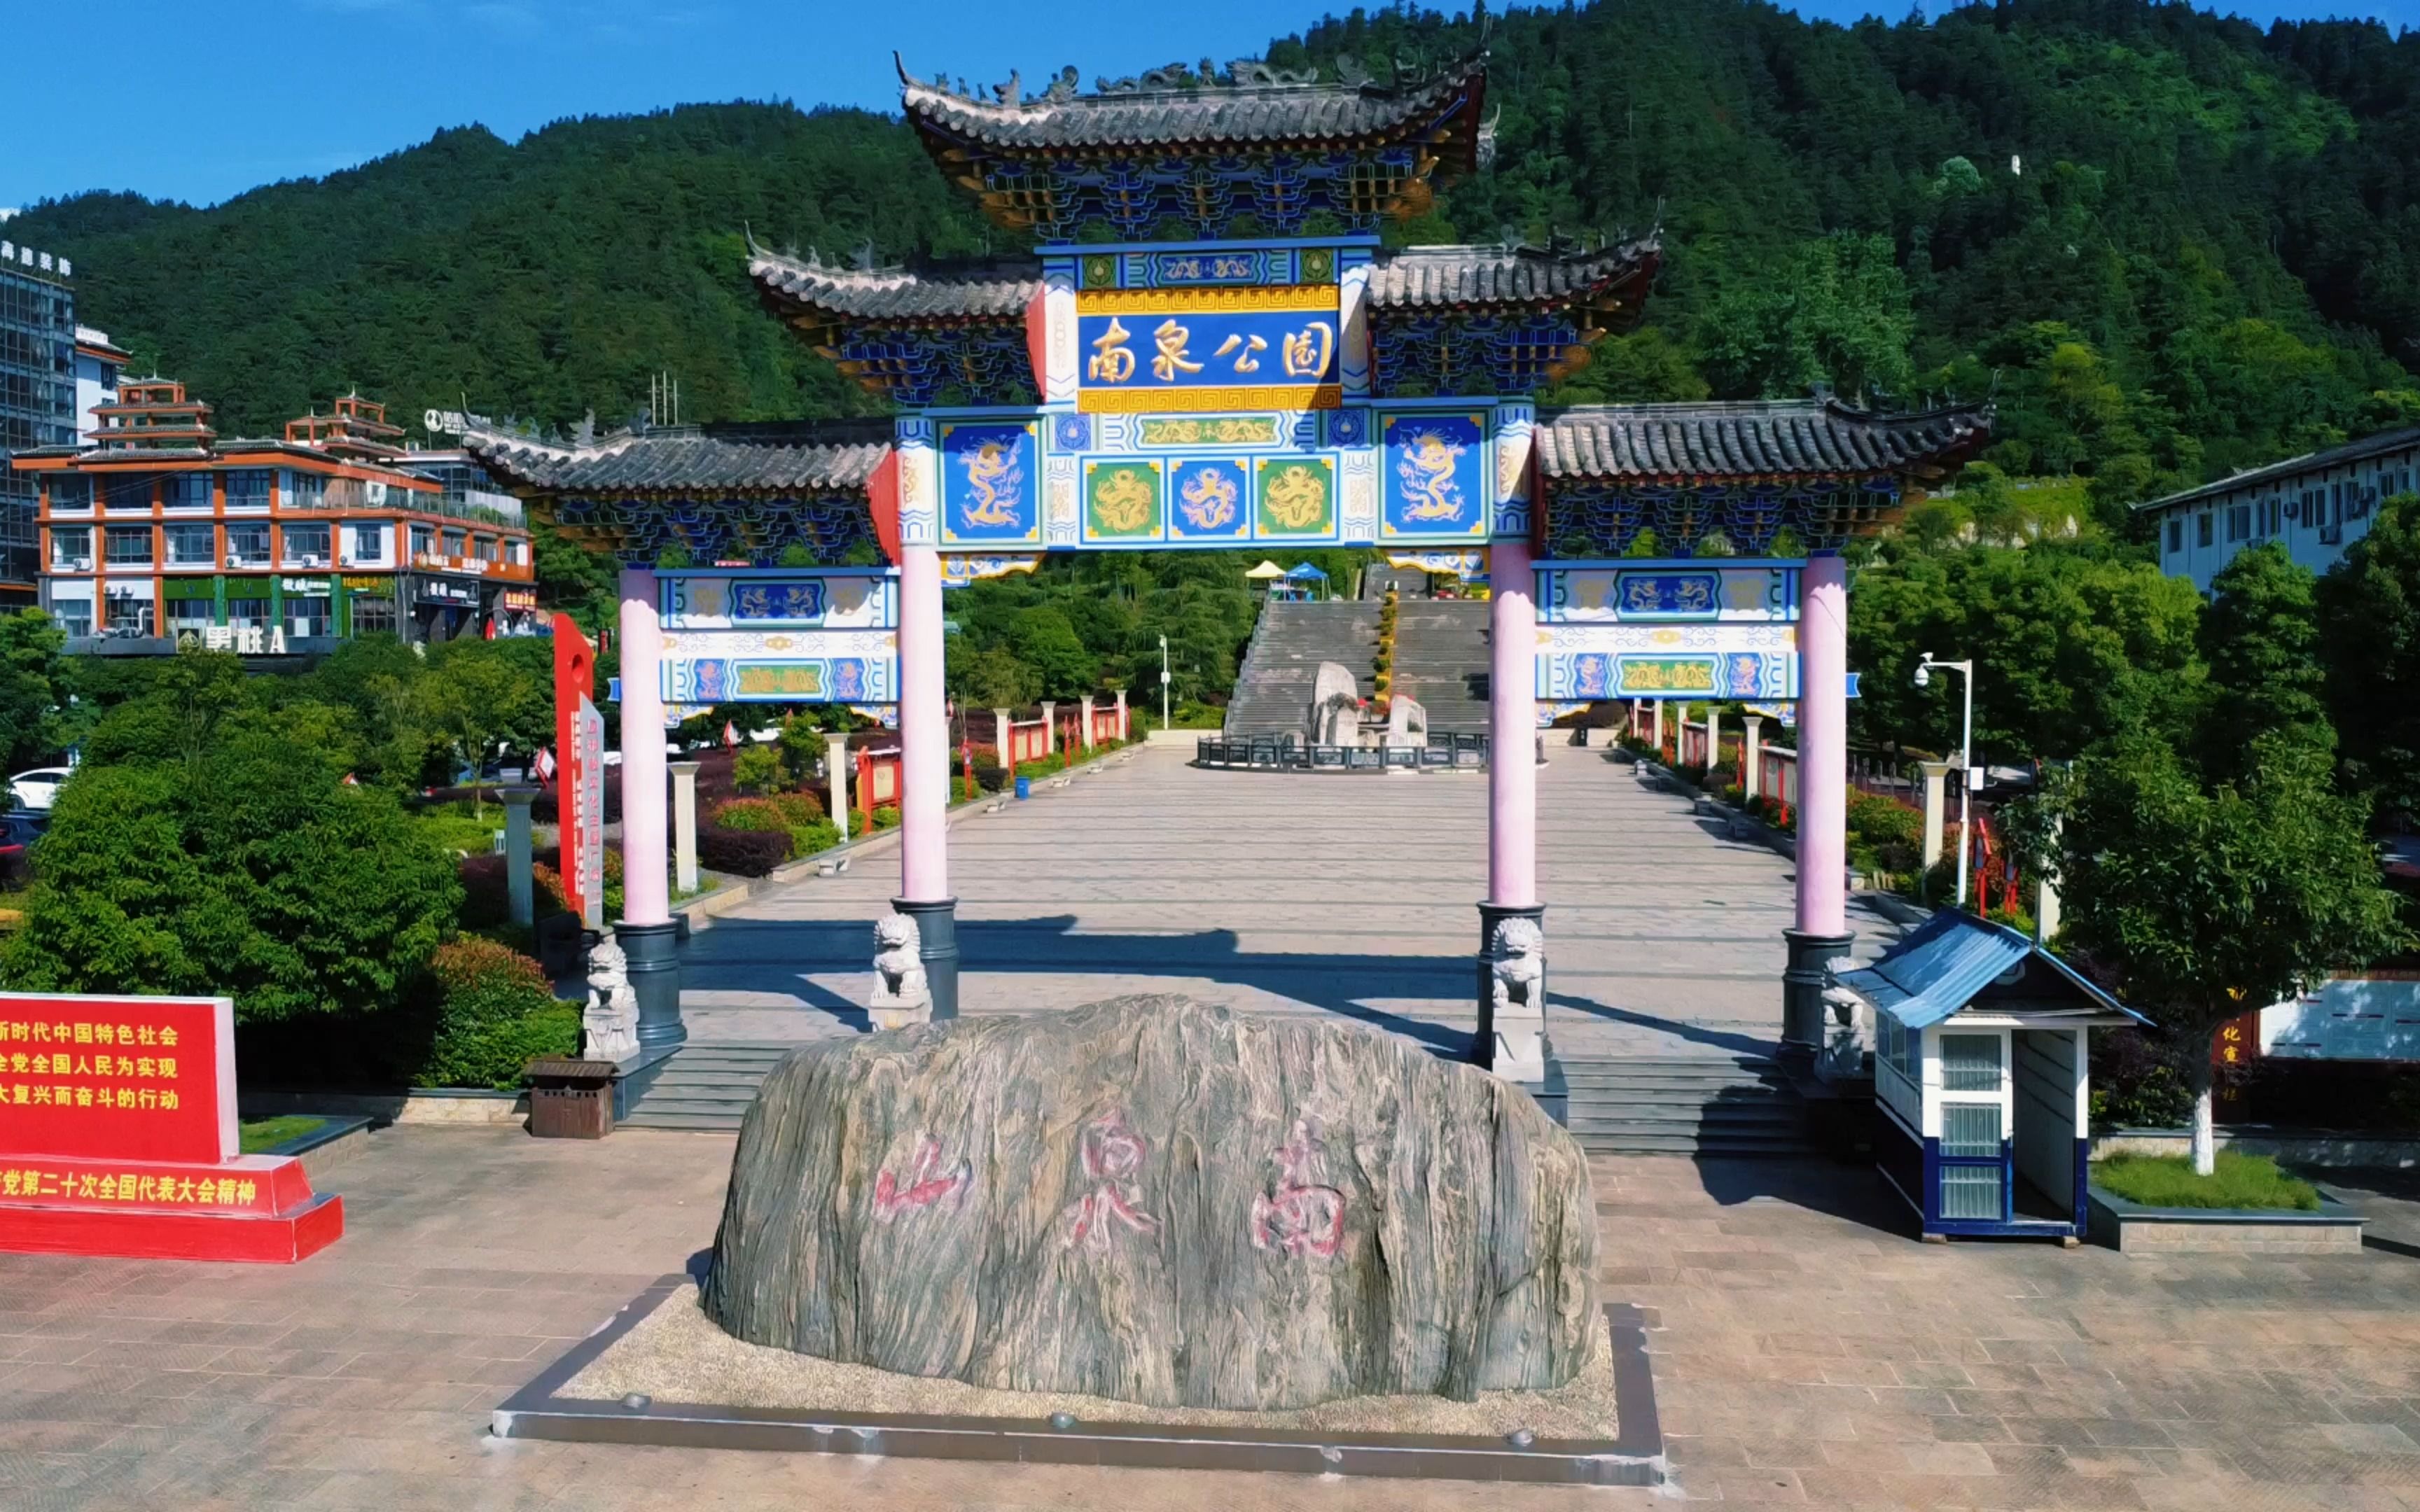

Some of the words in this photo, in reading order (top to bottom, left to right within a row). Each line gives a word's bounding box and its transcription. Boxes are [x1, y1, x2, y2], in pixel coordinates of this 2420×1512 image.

[0, 1169, 256, 1205] 党第二十次全国代表大会精神
